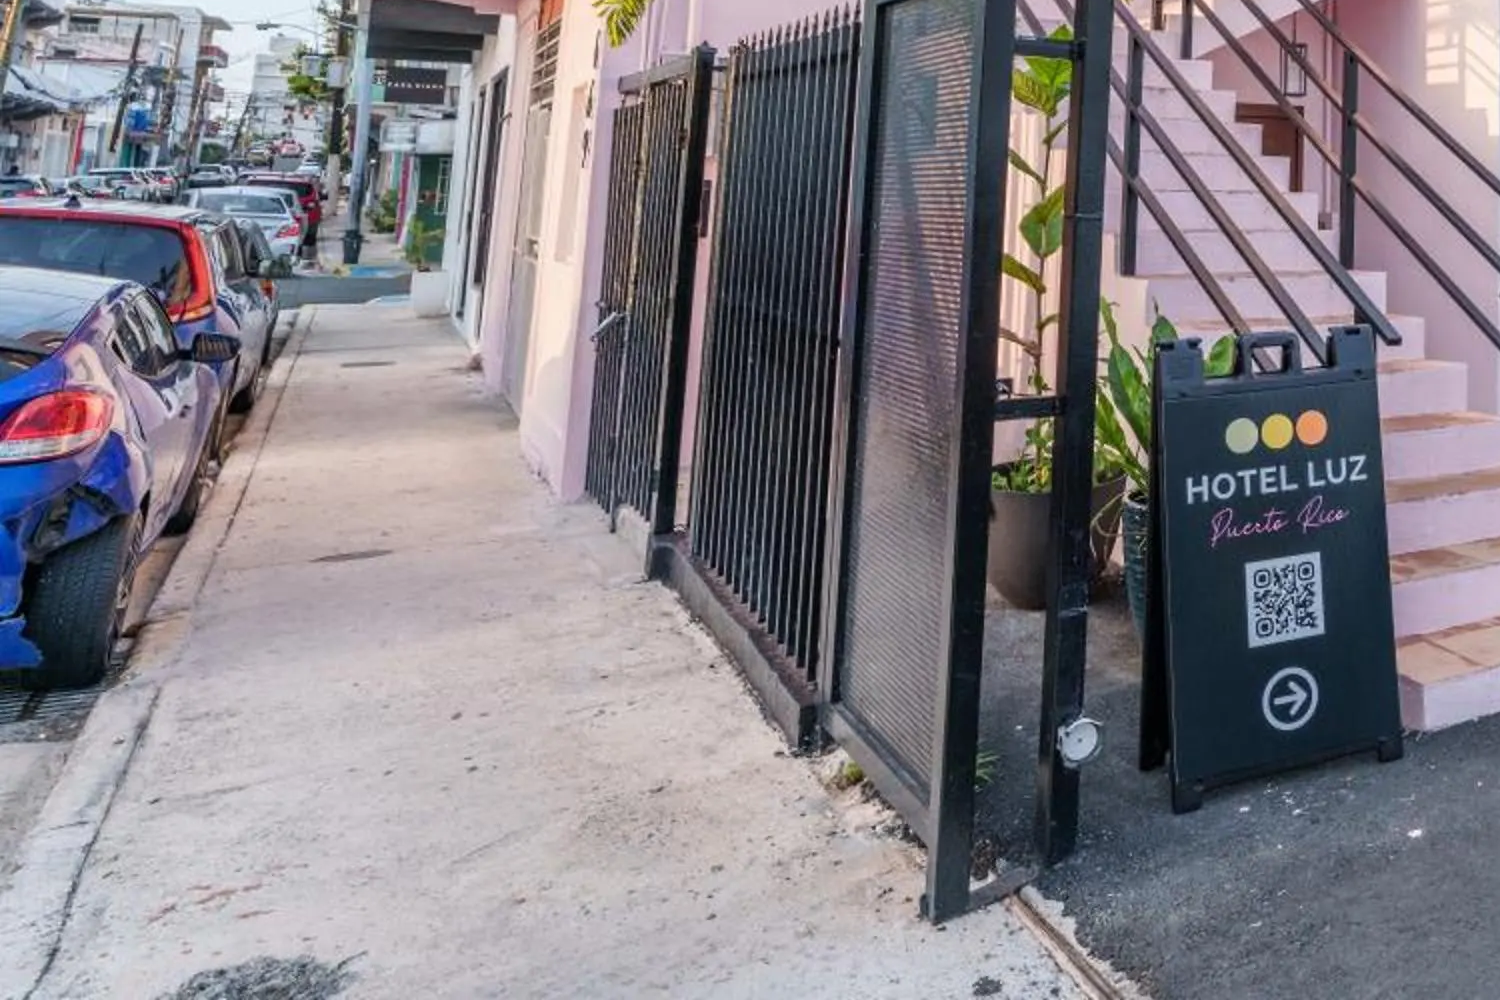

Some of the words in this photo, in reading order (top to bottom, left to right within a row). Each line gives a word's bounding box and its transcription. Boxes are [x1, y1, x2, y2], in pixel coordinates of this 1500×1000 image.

[1185, 464, 1299, 505] HOTEL
[1307, 454, 1369, 488] LUZ
[1210, 507, 1289, 548] Puerto
[1296, 494, 1350, 534] Rico
